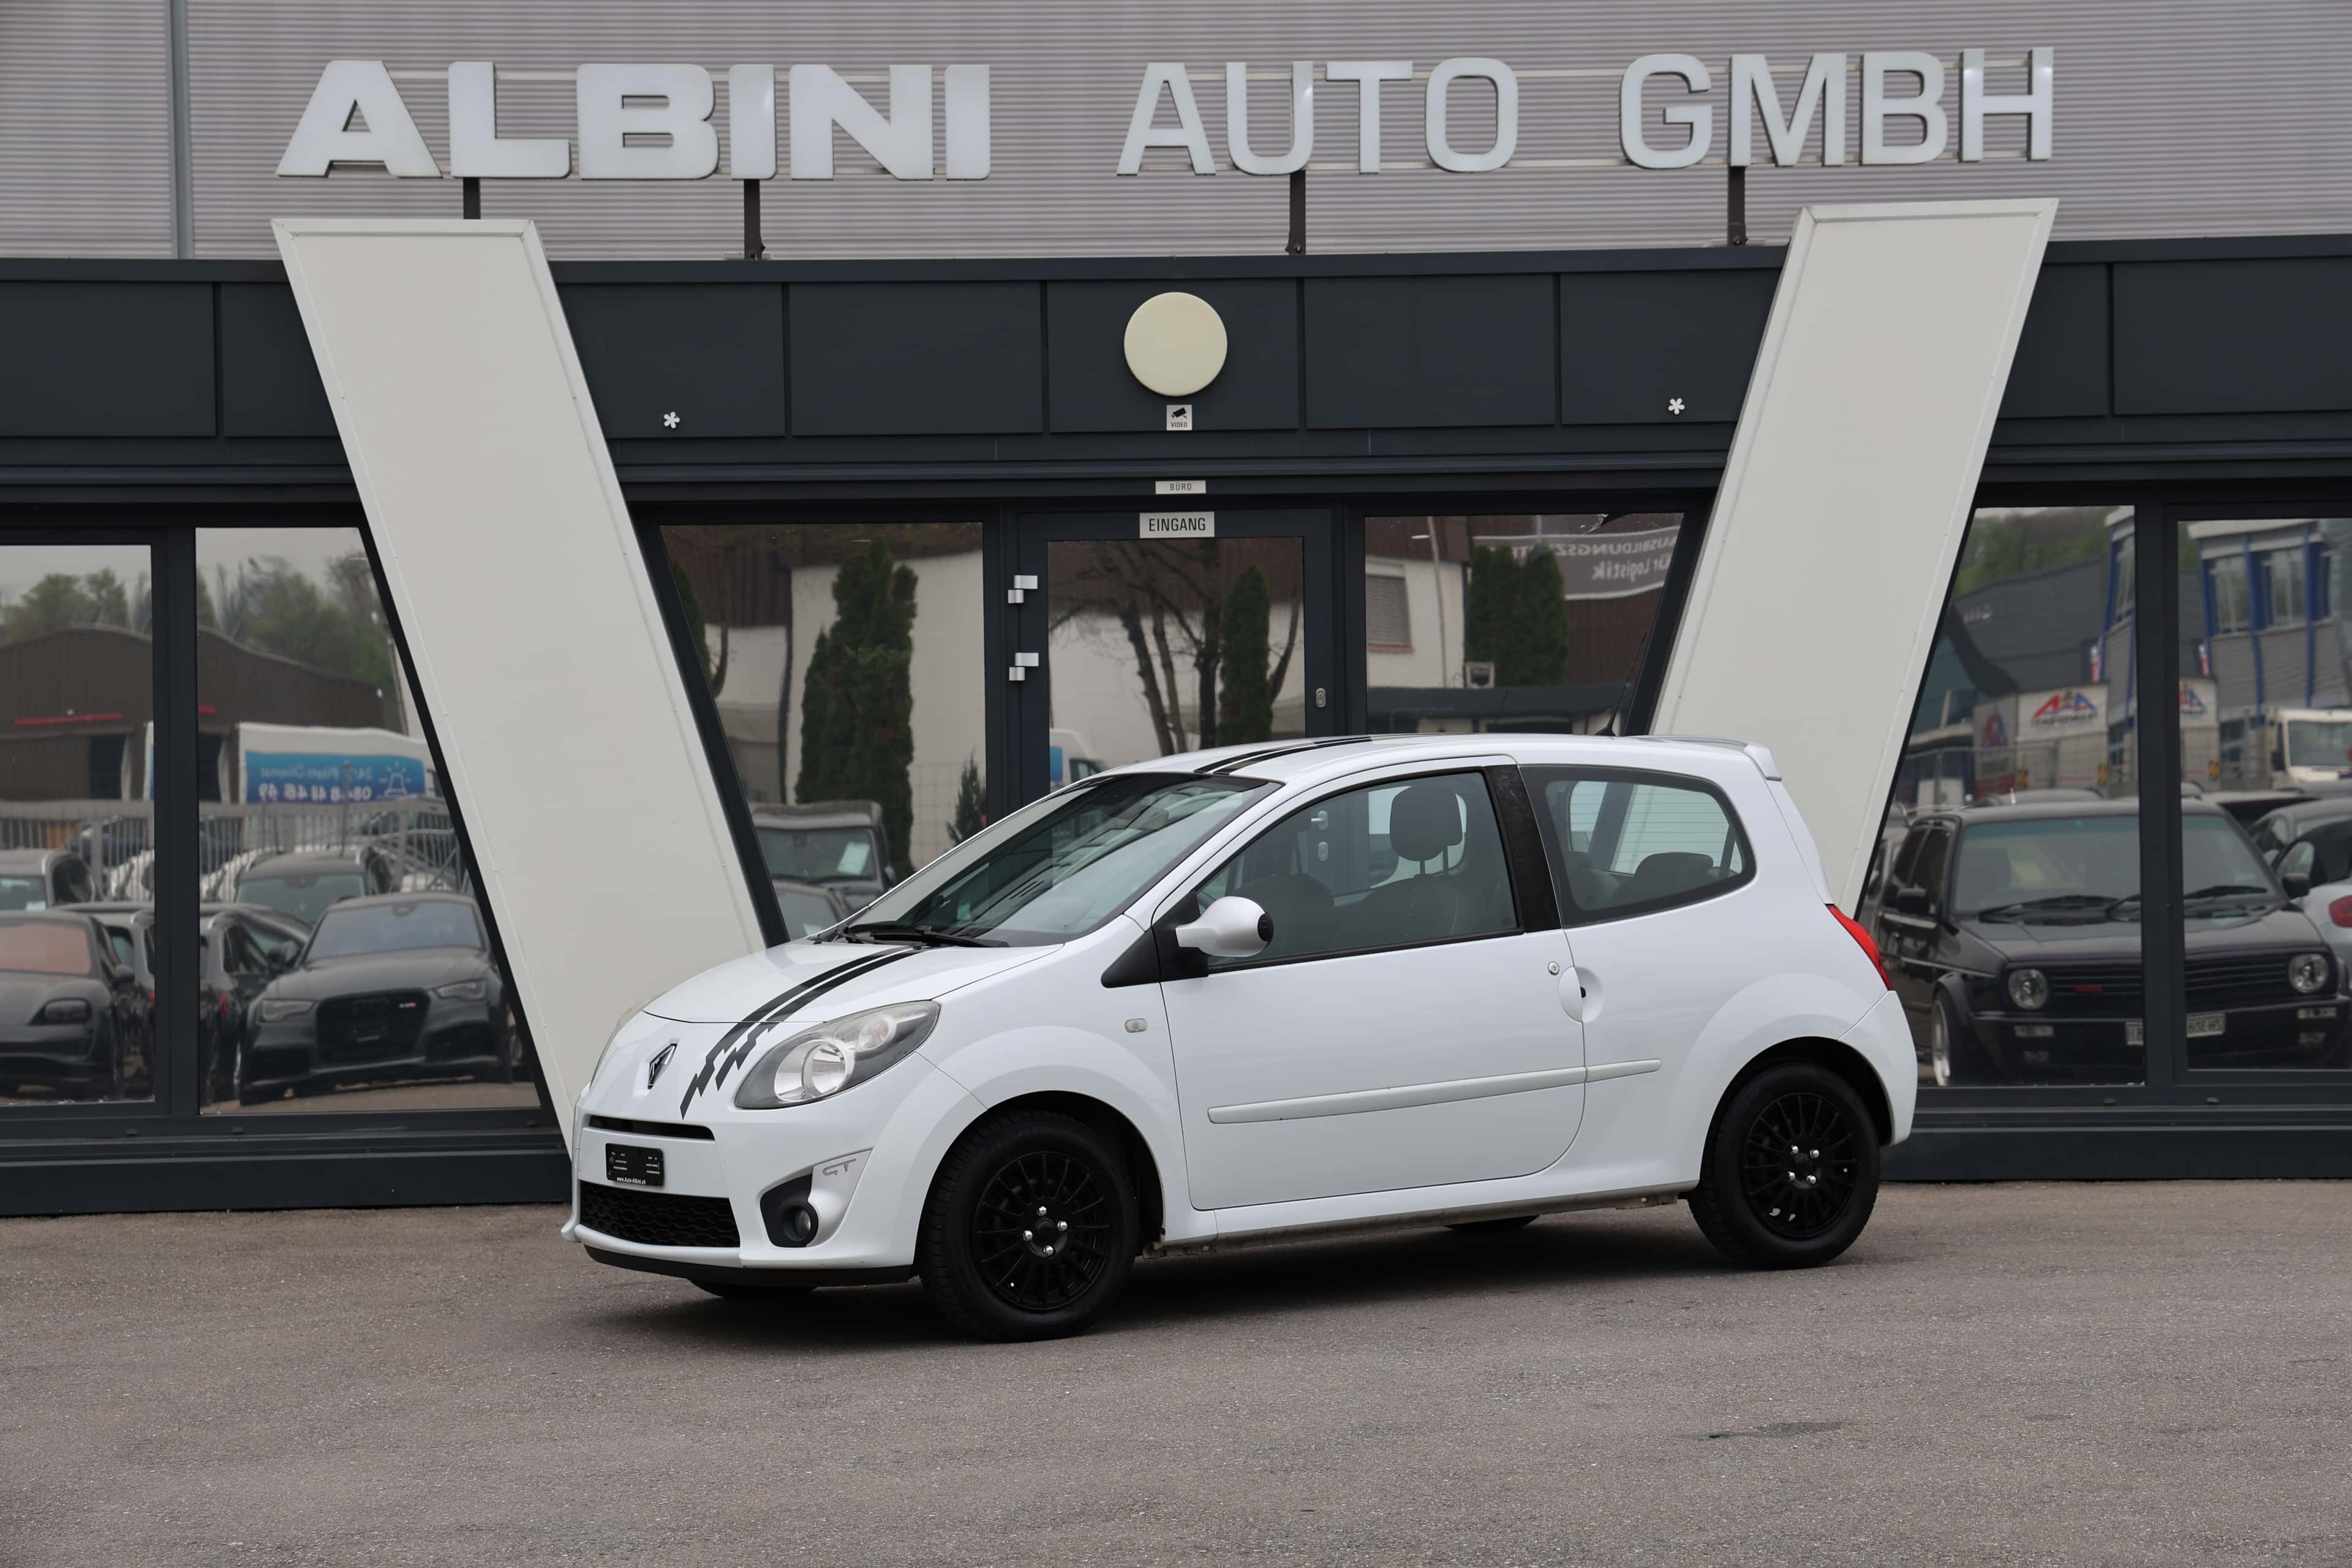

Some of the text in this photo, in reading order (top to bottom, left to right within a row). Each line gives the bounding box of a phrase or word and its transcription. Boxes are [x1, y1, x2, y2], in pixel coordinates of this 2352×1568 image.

[275, 47, 2054, 180] ALBINI AUTO GMBH
[1170, 482, 1192, 491] BÜRO
[1148, 518, 1206, 532] EINGANG
